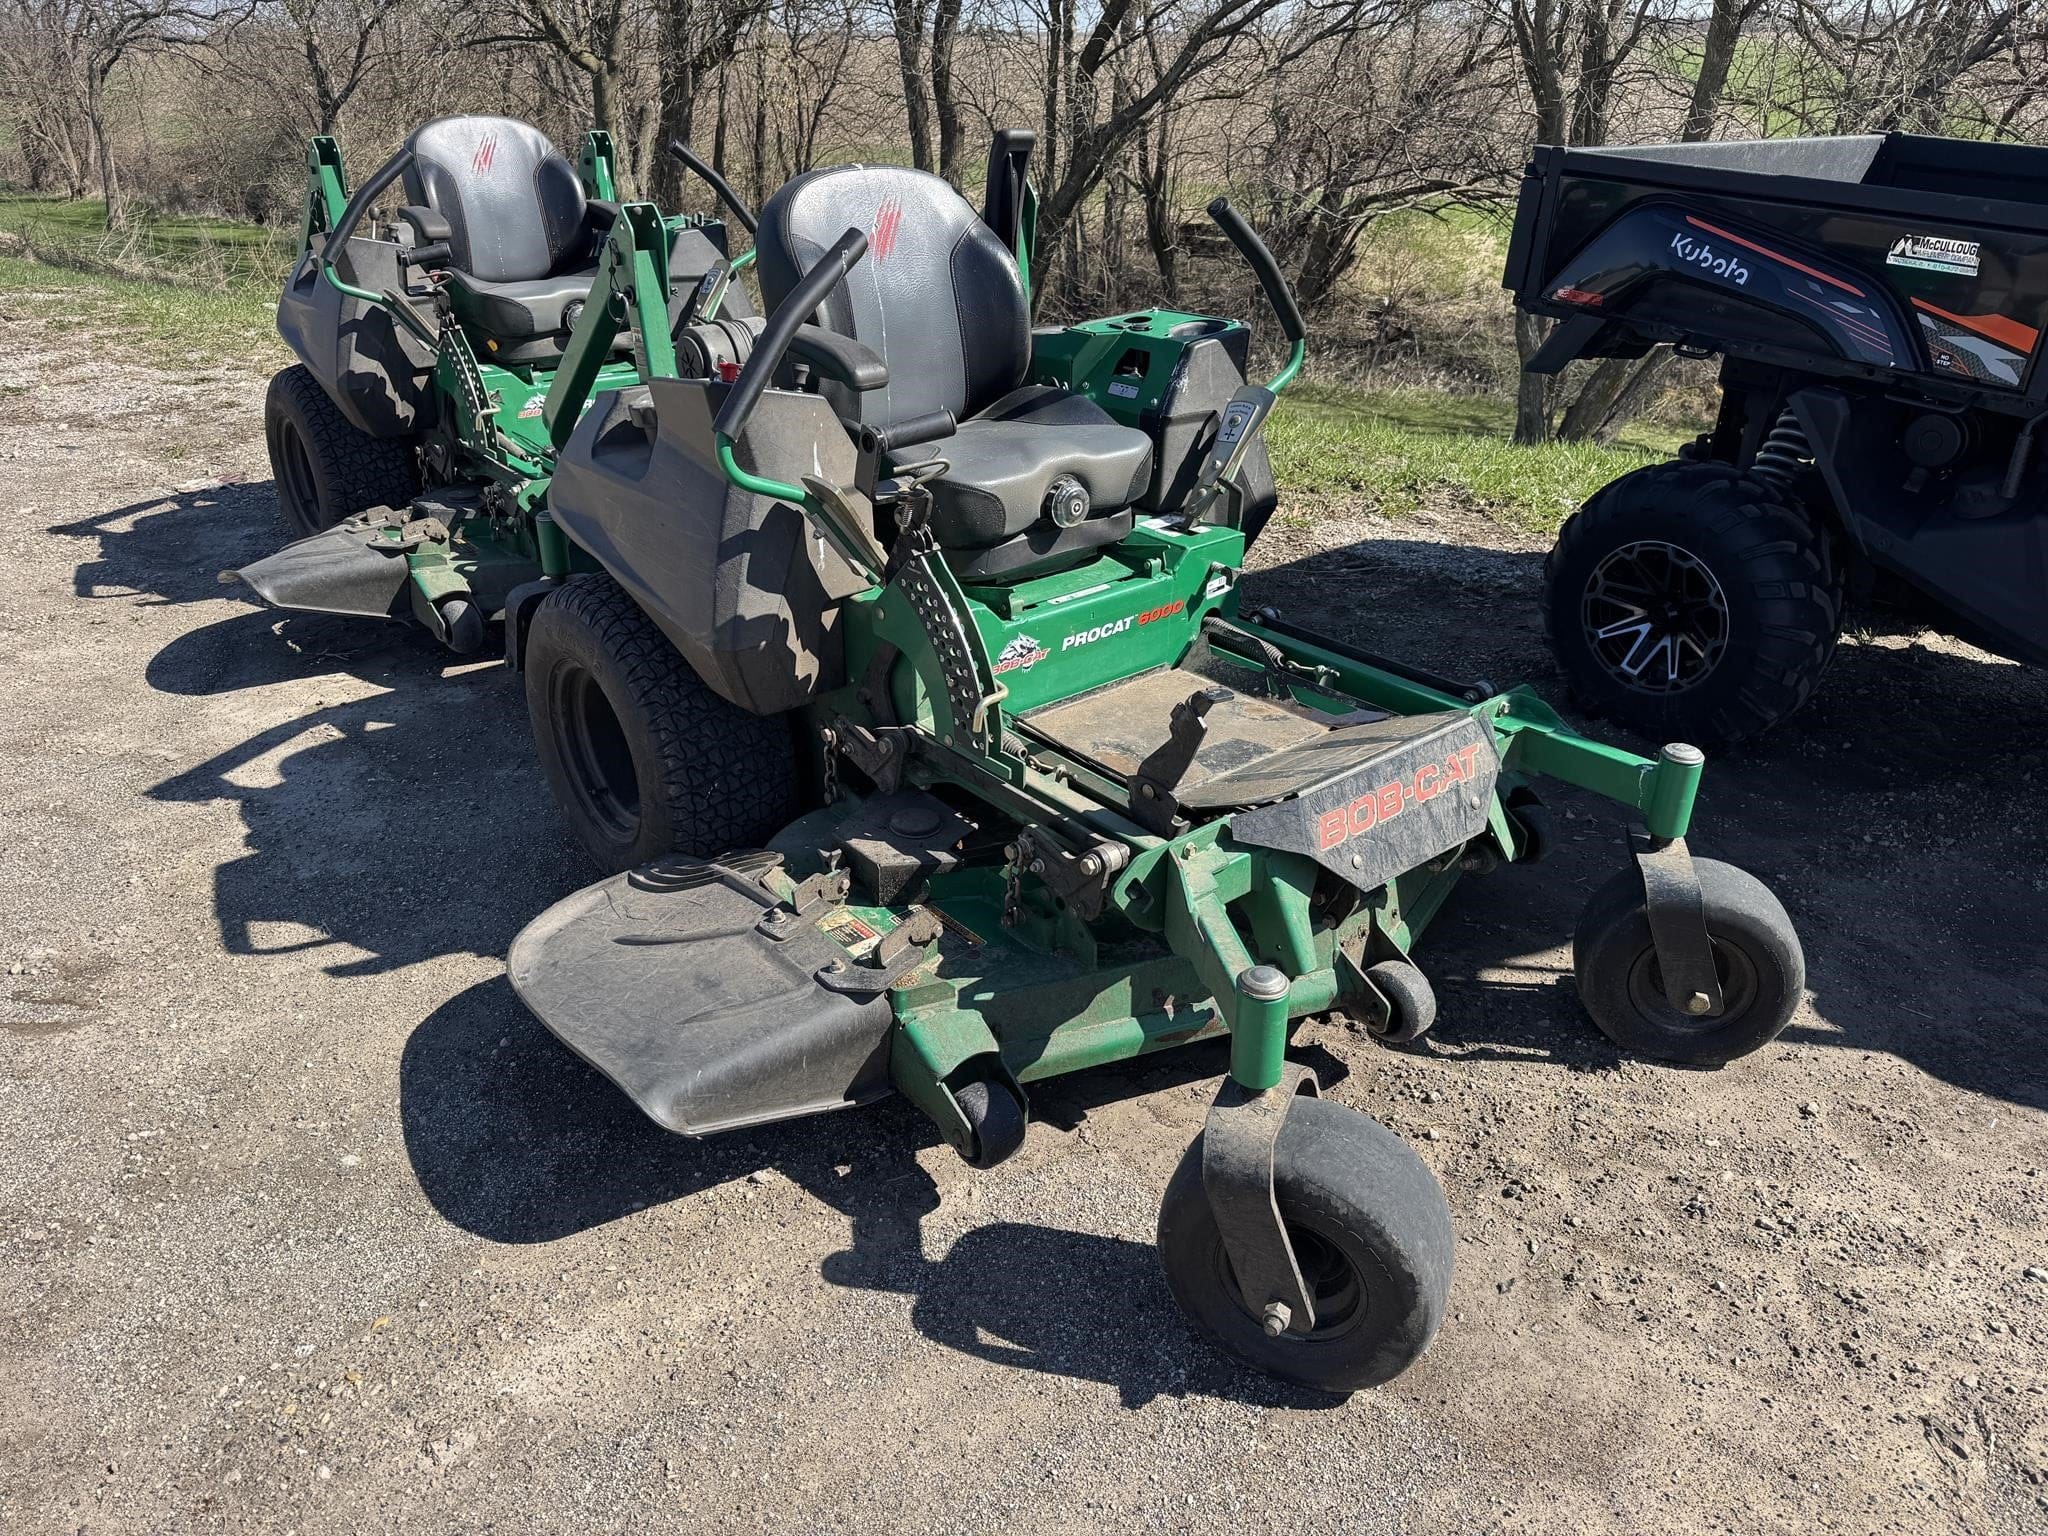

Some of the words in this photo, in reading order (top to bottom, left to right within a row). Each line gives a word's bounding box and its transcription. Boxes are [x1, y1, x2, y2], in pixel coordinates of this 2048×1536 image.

[1670, 233, 1749, 285] Kubota
[1062, 615, 1135, 651] PROCAT
[1137, 600, 1184, 626] 6000
[1319, 742, 1480, 851] BOB-CAT
